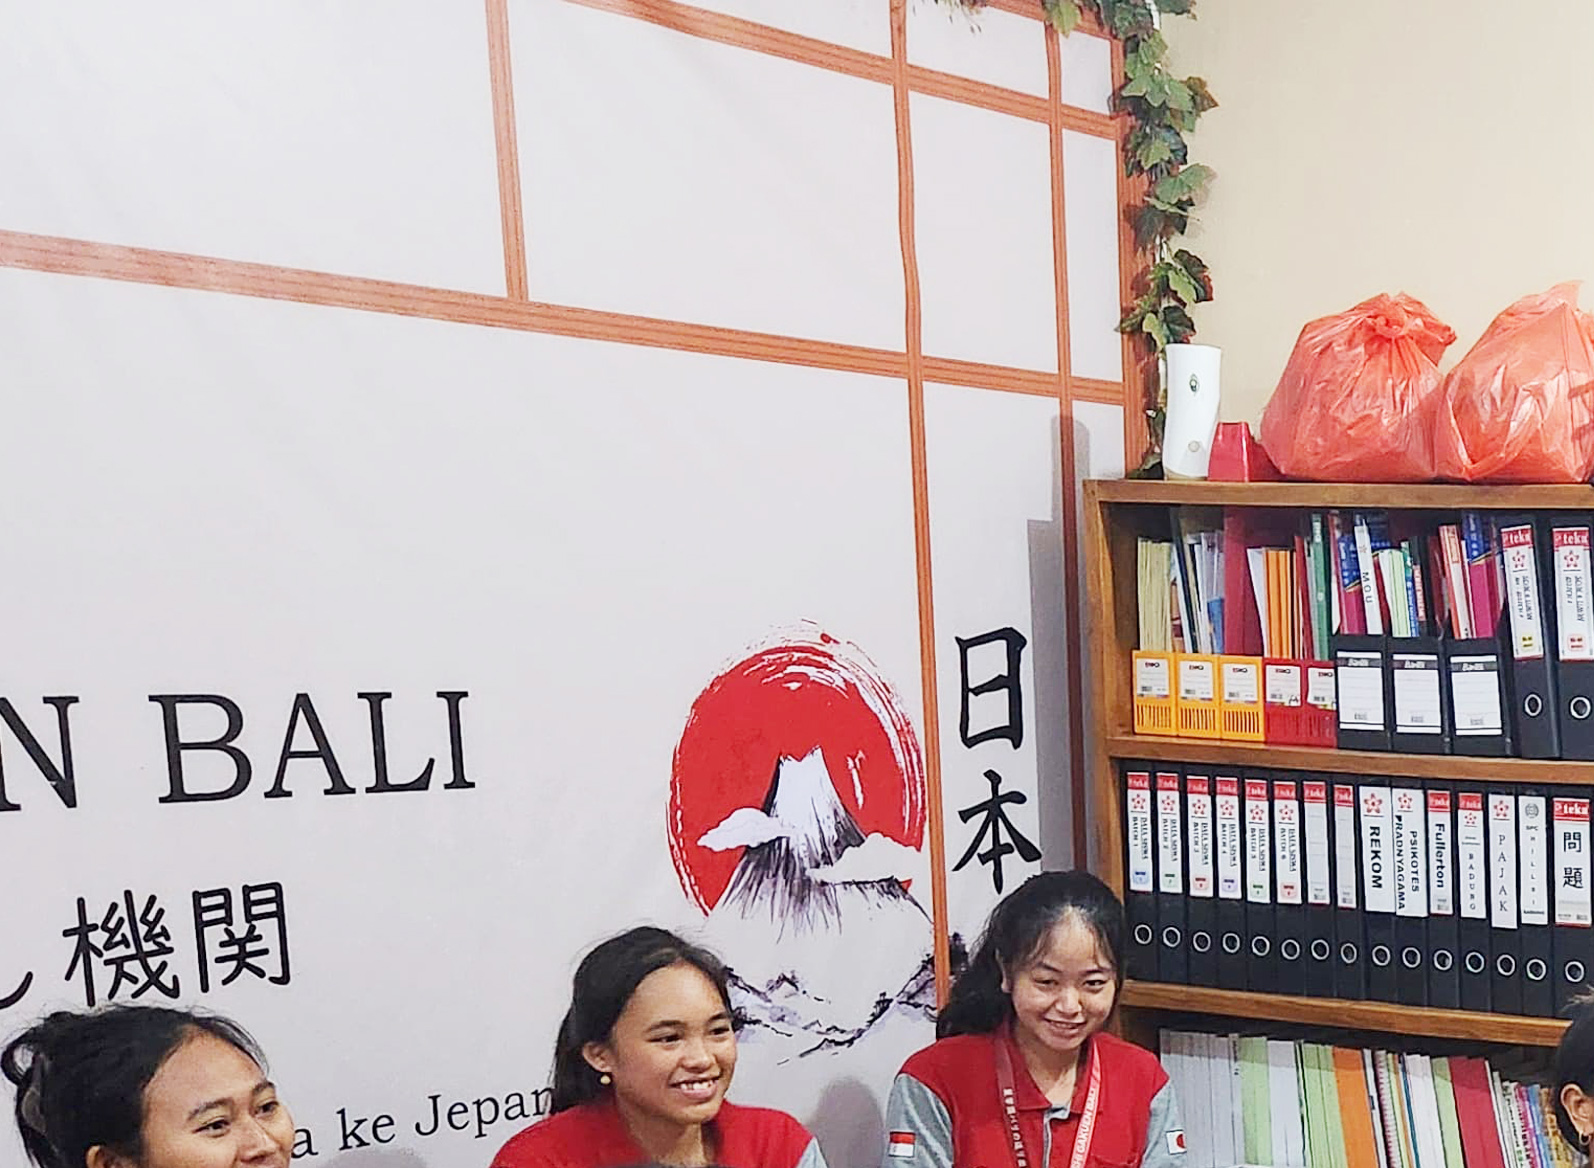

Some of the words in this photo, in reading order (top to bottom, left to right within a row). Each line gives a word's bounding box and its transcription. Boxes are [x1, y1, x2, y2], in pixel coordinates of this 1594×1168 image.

[1362, 571, 1373, 604] MOU
[148, 690, 476, 804] BALI
[952, 627, 1042, 895] 日本
[1369, 826, 1383, 889] REKOM
[1395, 815, 1405, 910] PRADNYAGAMA
[1410, 830, 1420, 892] PSIKOTES
[1435, 823, 1446, 888] Fullerton
[1498, 834, 1508, 912] PAJAK
[1563, 831, 1584, 889] 問題
[336, 1107, 396, 1151] ke
[415, 1094, 555, 1139] Jepan
